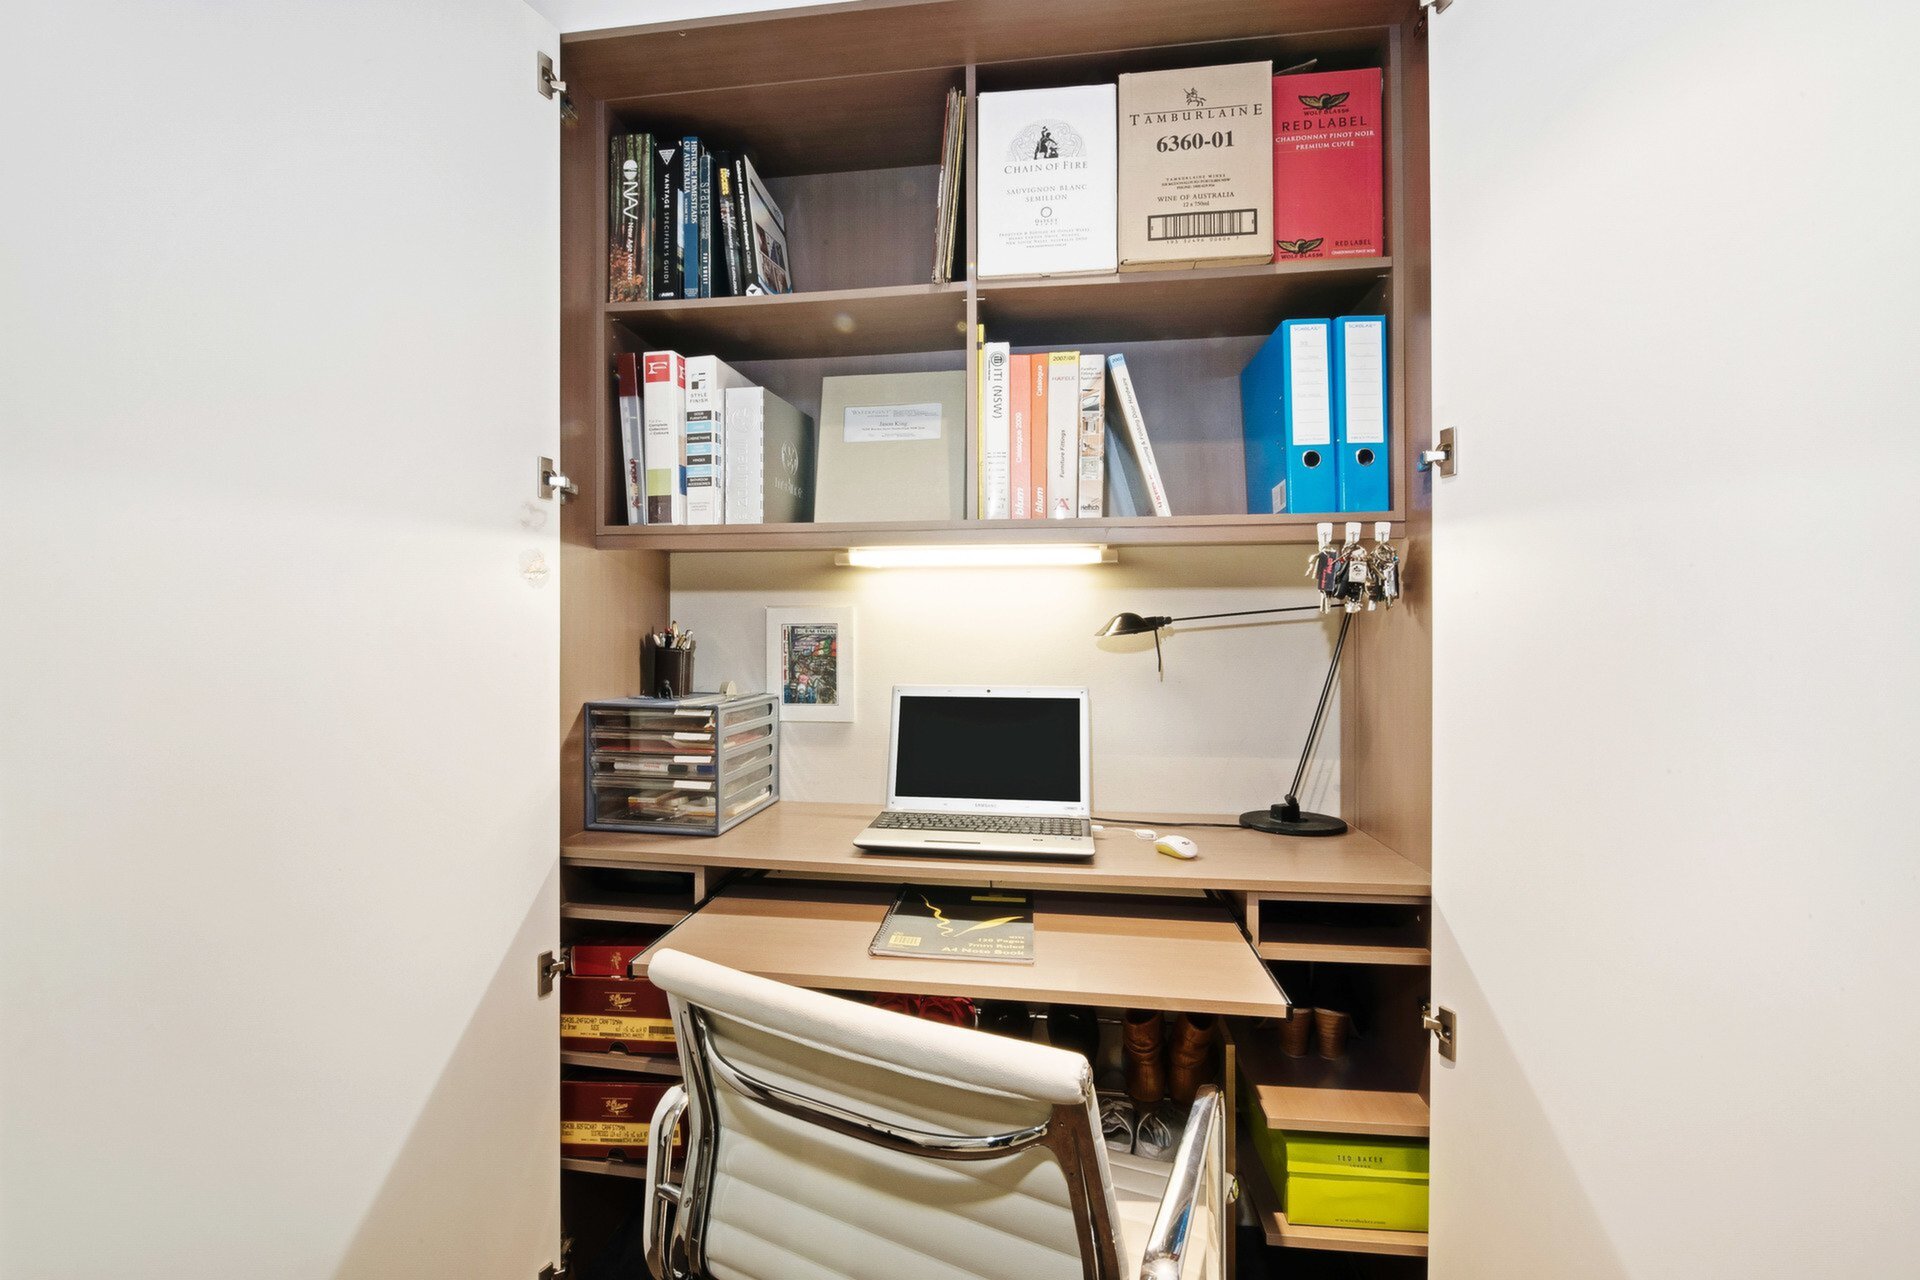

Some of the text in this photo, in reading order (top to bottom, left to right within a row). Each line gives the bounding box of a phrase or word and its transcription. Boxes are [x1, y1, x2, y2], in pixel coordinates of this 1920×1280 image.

[1129, 103, 1263, 126] TAMBURLAINE
[1281, 116, 1367, 131] RED LABEL
[1156, 130, 1235, 153] 6360-01
[1275, 133, 1327, 143] CHARDONNAY
[1329, 131, 1353, 139] PINOT
[684, 141, 690, 152] OF
[1295, 142, 1330, 151] PREMIUM
[1004, 161, 1088, 174] CHAIN OF FIRE
[1006, 185, 1056, 195] SAUVIGNON
[1192, 191, 1235, 200] AUSTRALIA
[622, 181, 639, 220] NAV
[1024, 193, 1068, 203] SEMILLON
[1036, 364, 1044, 397] Catalogue
[992, 368, 1003, 419] ITI (NSW)
[1016, 486, 1024, 516] blum
[1035, 486, 1044, 513] blum
